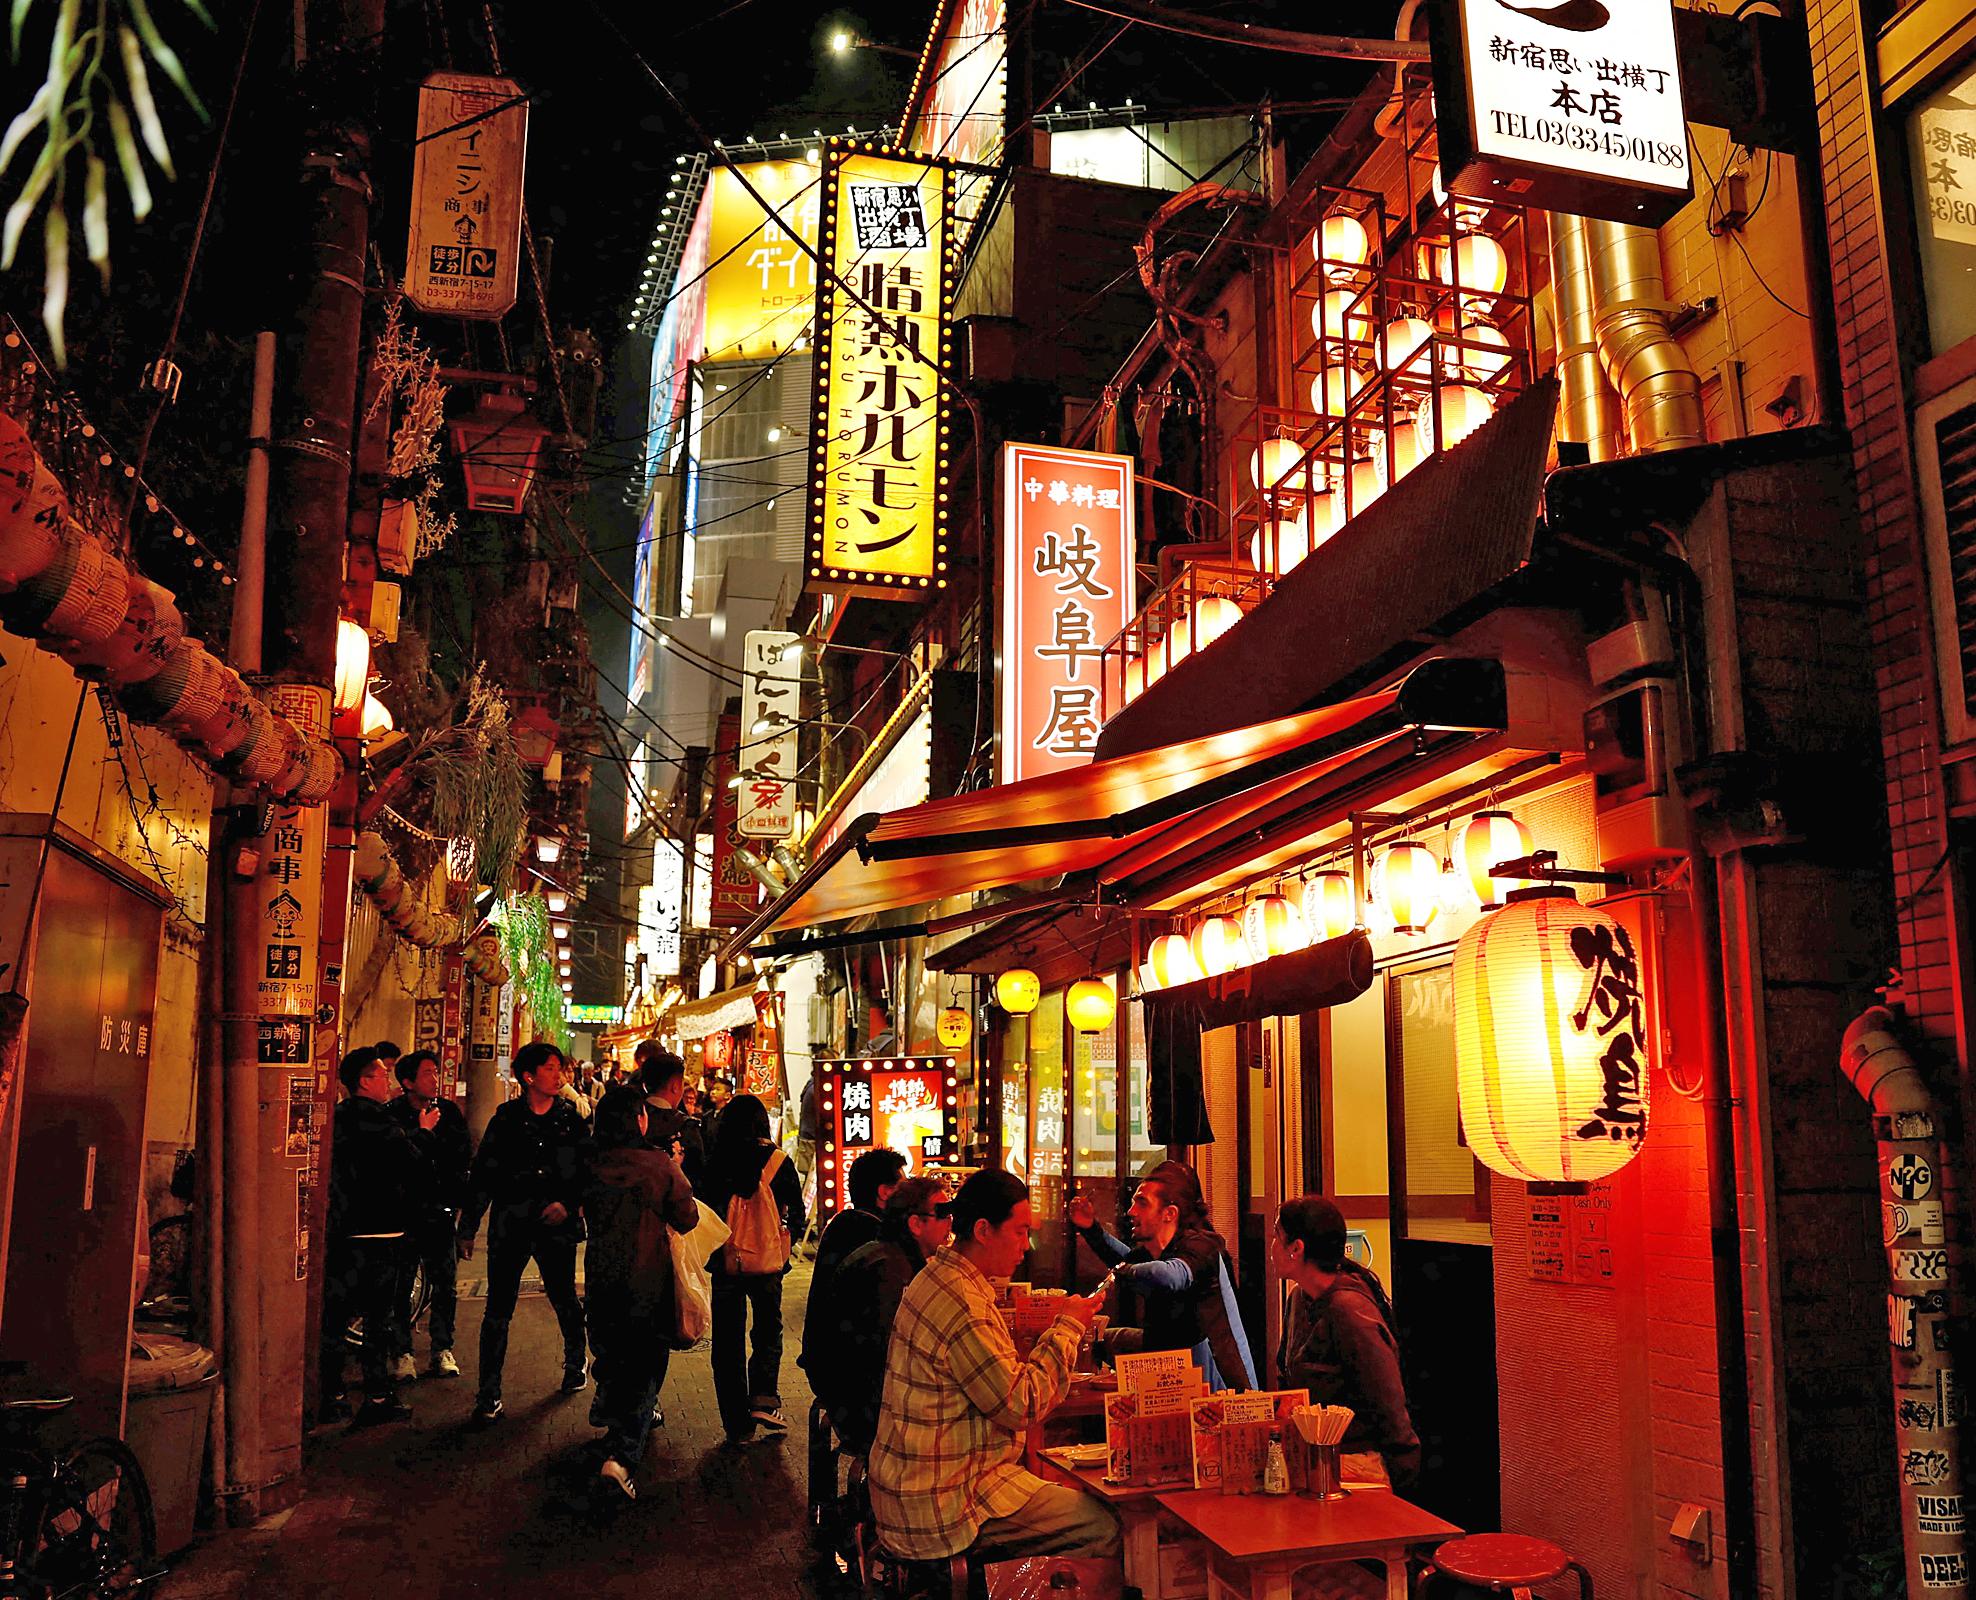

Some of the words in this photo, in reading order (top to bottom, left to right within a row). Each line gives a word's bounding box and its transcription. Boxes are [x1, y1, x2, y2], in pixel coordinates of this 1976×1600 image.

[1488, 35, 1671, 95] 新宿思い出横丁
[1549, 80, 1623, 126] 本店
[853, 187, 920, 207] 新宿思い
[858, 206, 921, 228] 出横丁
[860, 226, 926, 248] 酒場
[433, 247, 460, 260] 徒歩
[434, 261, 459, 274] 7分
[854, 263, 925, 554] 情熱ホルモン
[834, 408, 853, 553] HORUMON
[1024, 476, 1121, 509] 中華料理
[1035, 526, 1109, 755] 岐阜屋
[270, 949, 299, 961] 徒歩
[271, 962, 299, 976] 7分
[100, 1015, 149, 1058] 防災庫
[257, 1026, 302, 1041] 西新宿
[748, 1052, 774, 1087] おでん
[842, 1081, 871, 1142] 焼肉
[1890, 1165, 1930, 1187] N?G
[1574, 1196, 1592, 1209] Cash
[1594, 1196, 1613, 1210] Only
[1919, 1521, 1943, 1532] MADE
[1944, 1522, 1950, 1533] U
